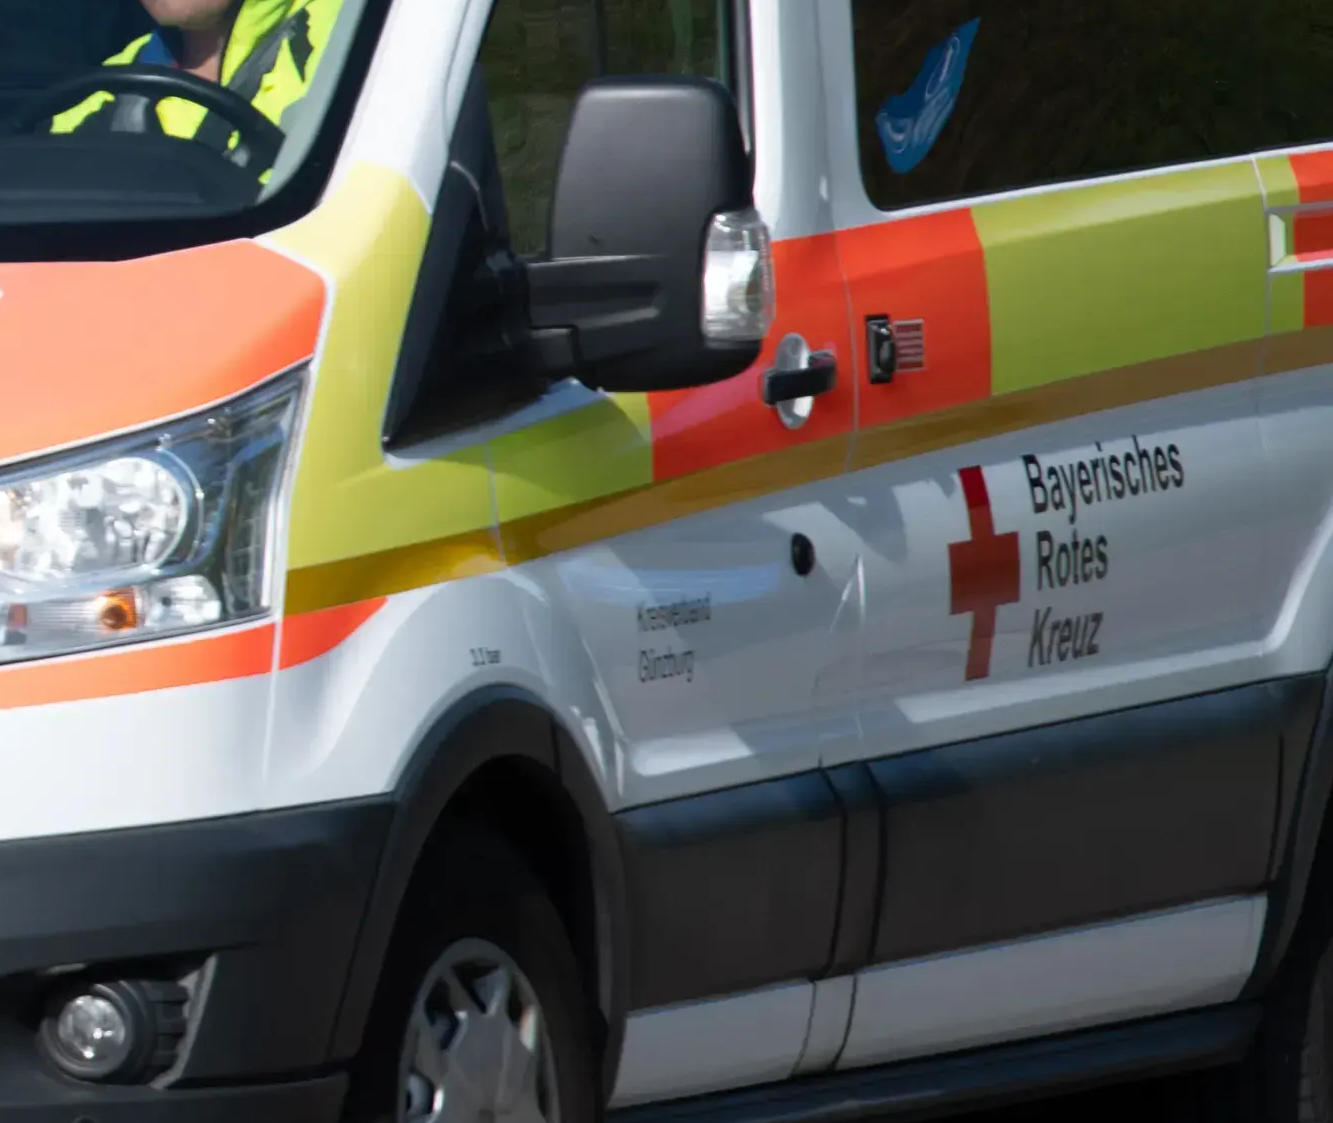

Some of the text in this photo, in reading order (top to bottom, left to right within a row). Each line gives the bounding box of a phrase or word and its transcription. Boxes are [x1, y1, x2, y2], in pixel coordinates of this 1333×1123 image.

[1021, 435, 1184, 524] Bayerisches
[1036, 530, 1109, 592] Rotes
[1027, 608, 1104, 668] Kreuz
